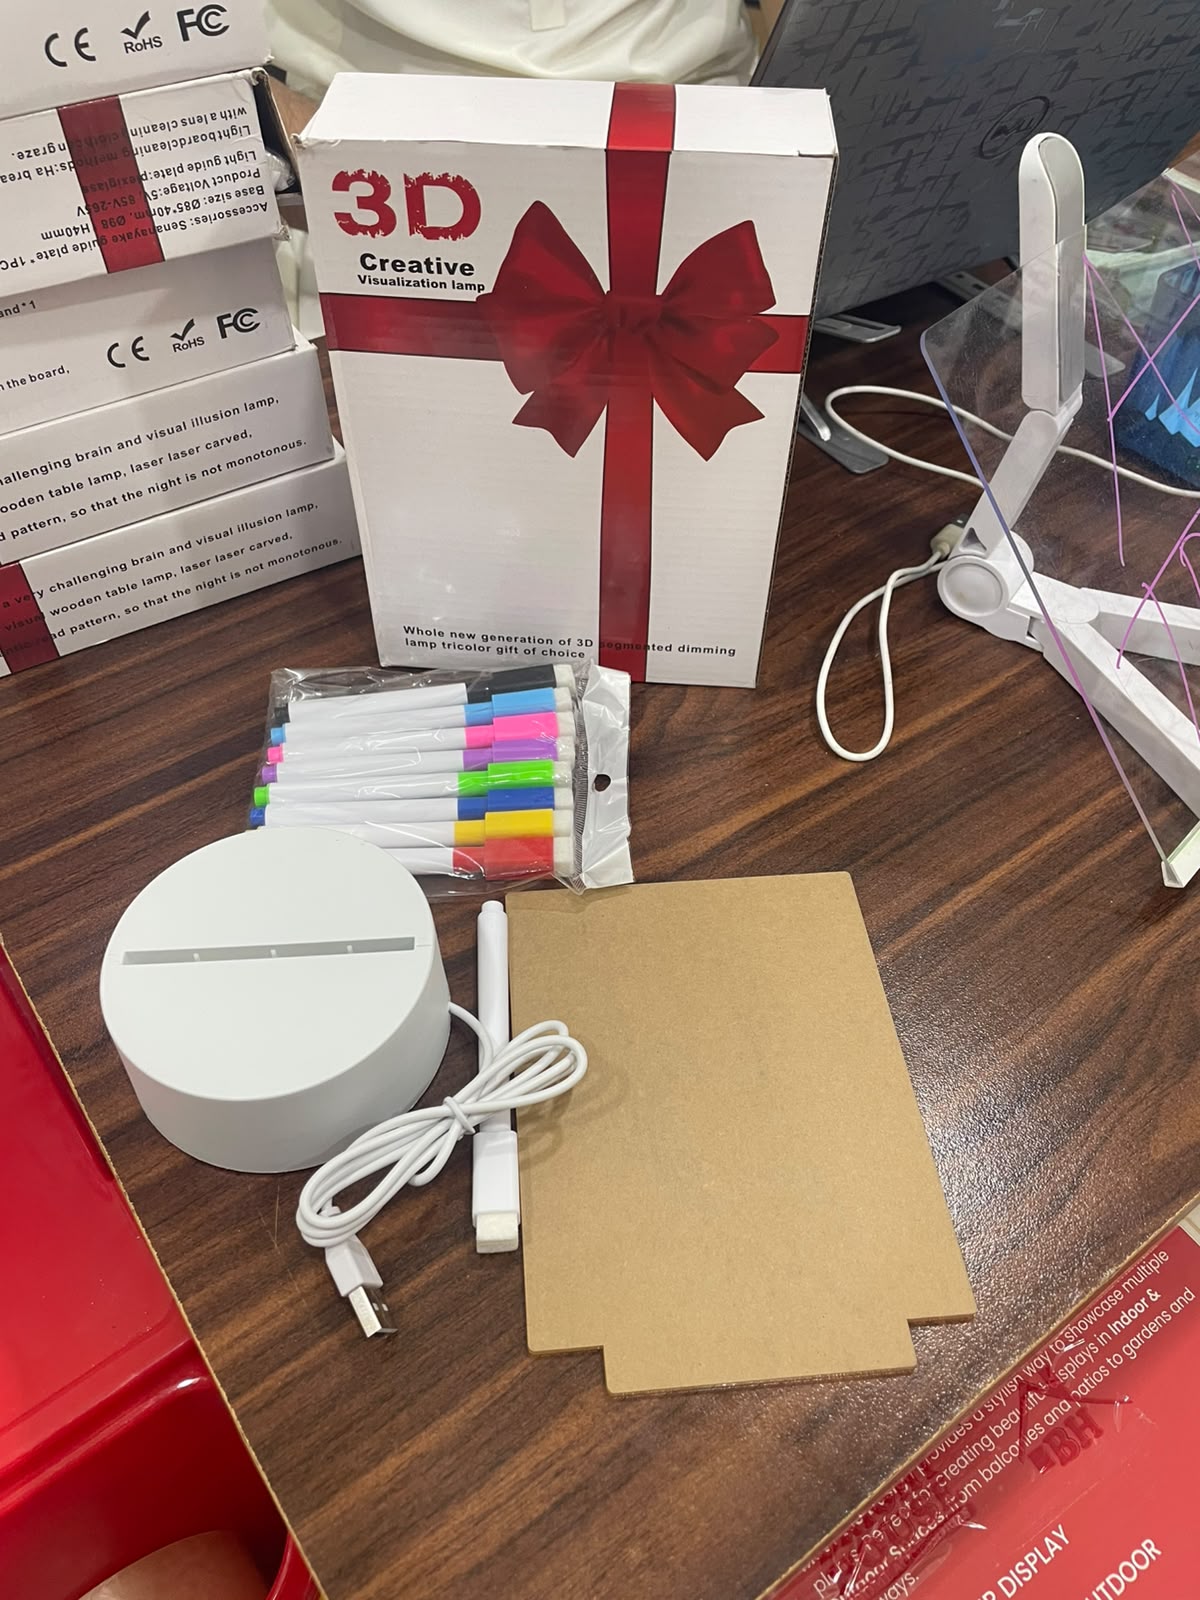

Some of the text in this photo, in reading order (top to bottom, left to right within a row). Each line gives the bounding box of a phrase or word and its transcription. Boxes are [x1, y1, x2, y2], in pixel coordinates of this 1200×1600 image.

[44, 27, 97, 68] CE
[123, 35, 164, 54] RoHS
[180, 114, 209, 125] lens
[220, 106, 248, 118] with
[187, 155, 222, 172] guide
[225, 150, 257, 162] Light
[212, 168, 261, 186] Product
[235, 185, 265, 198] Base
[204, 191, 233, 205] size:
[331, 168, 482, 242] 3D
[190, 201, 268, 226] Accessories:
[41, 223, 91, 241] H40mm
[72, 235, 108, 253] guide
[359, 252, 475, 277] Creative
[357, 274, 485, 293] Visualization lamp
[106, 335, 150, 368] CE
[172, 336, 205, 352] RoHS
[6, 377, 27, 389] the
[28, 364, 70, 383] board,
[75, 445, 112, 462] brain
[117, 435, 142, 451] and
[146, 421, 187, 441] visual
[191, 406, 240, 428] illusion
[244, 396, 279, 412] lamp,
[48, 481, 84, 498] table
[88, 469, 127, 487] lamp,
[130, 457, 165, 473] laser
[168, 446, 201, 462] laser
[205, 429, 253, 450] carved,
[11, 515, 67, 540] pattern,
[70, 508, 87, 519] so
[91, 496, 118, 512] that
[122, 489, 143, 503] the
[147, 476, 182, 494] night
[185, 471, 197, 482] is
[201, 463, 223, 477] not
[226, 438, 307, 469] monotonous.
[49, 562, 128, 593] challenging
[131, 550, 165, 567] brain
[169, 540, 192, 555] and
[195, 527, 234, 546] visual
[237, 512, 283, 533] illusion
[286, 502, 319, 517] lamp,
[49, 595, 102, 617] wooden
[105, 581, 138, 599] table
[142, 570, 177, 587] lamp,
[180, 558, 211, 574] laser
[215, 548, 246, 564] laser
[70, 612, 121, 635] pattern,
[124, 604, 140, 615] so
[143, 594, 168, 609] that
[172, 586, 192, 599] the
[195, 574, 227, 592] night
[230, 570, 241, 580] is
[245, 562, 264, 575] not
[267, 536, 343, 567] monotonous.
[403, 625, 736, 658] Whole new generation of 3D segmented dimming
[405, 637, 586, 659] lamp tricolor gift of choice
[1022, 1353, 1053, 1379] way
[1048, 1339, 1066, 1356] to
[1063, 1288, 1125, 1343] showcase
[1123, 1250, 1170, 1294] multiple
[1106, 1351, 1124, 1369] to
[1122, 1309, 1172, 1361] gardens
[1169, 1286, 1196, 1314] and
[936, 1434, 996, 1487] creating
[1098, 1331, 1112, 1347] in
[1107, 1296, 1149, 1336] Indoor
[1145, 1288, 1162, 1303] &
[997, 1523, 1070, 1599] DISPLAY
